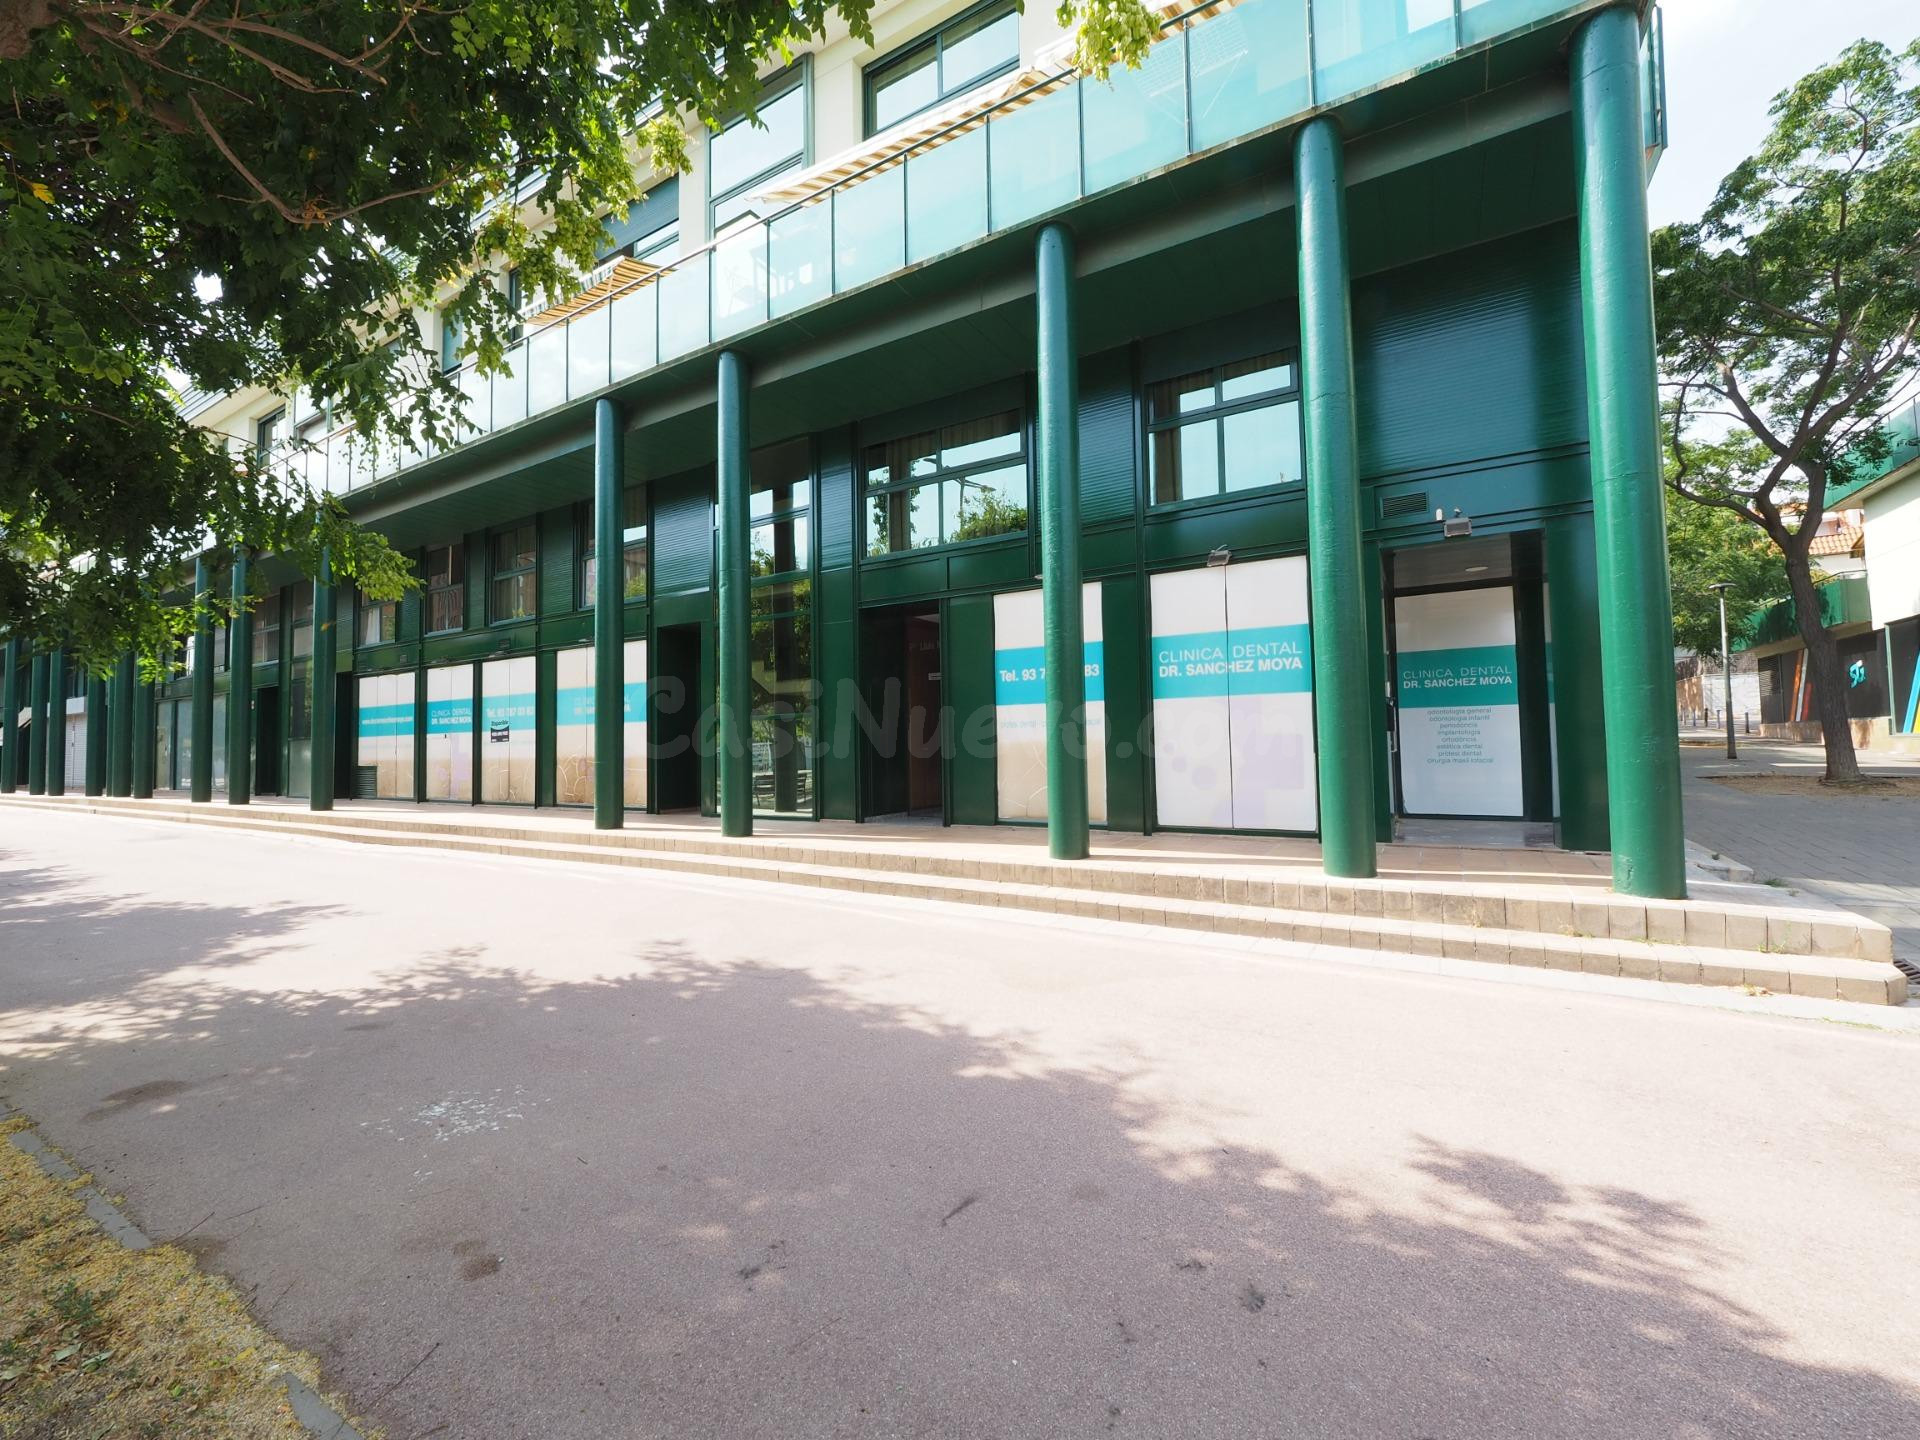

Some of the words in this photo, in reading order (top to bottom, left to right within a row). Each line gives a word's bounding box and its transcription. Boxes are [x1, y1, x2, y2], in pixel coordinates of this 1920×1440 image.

[1159, 647, 1224, 664] CLINICA
[1233, 641, 1303, 658] DENTAL
[1000, 669, 1019, 682] Tel.
[1022, 668, 1037, 681] 93
[1159, 665, 1182, 678] DR.
[1186, 660, 1255, 676] SANCHEZ
[1258, 657, 1303, 671] MOYA
[1403, 669, 1453, 680] CLINICA
[1460, 665, 1513, 677] DENTAL
[1403, 680, 1422, 689] DR.
[1424, 677, 1477, 688] SANCHEZ
[1479, 675, 1513, 686] MOYA
